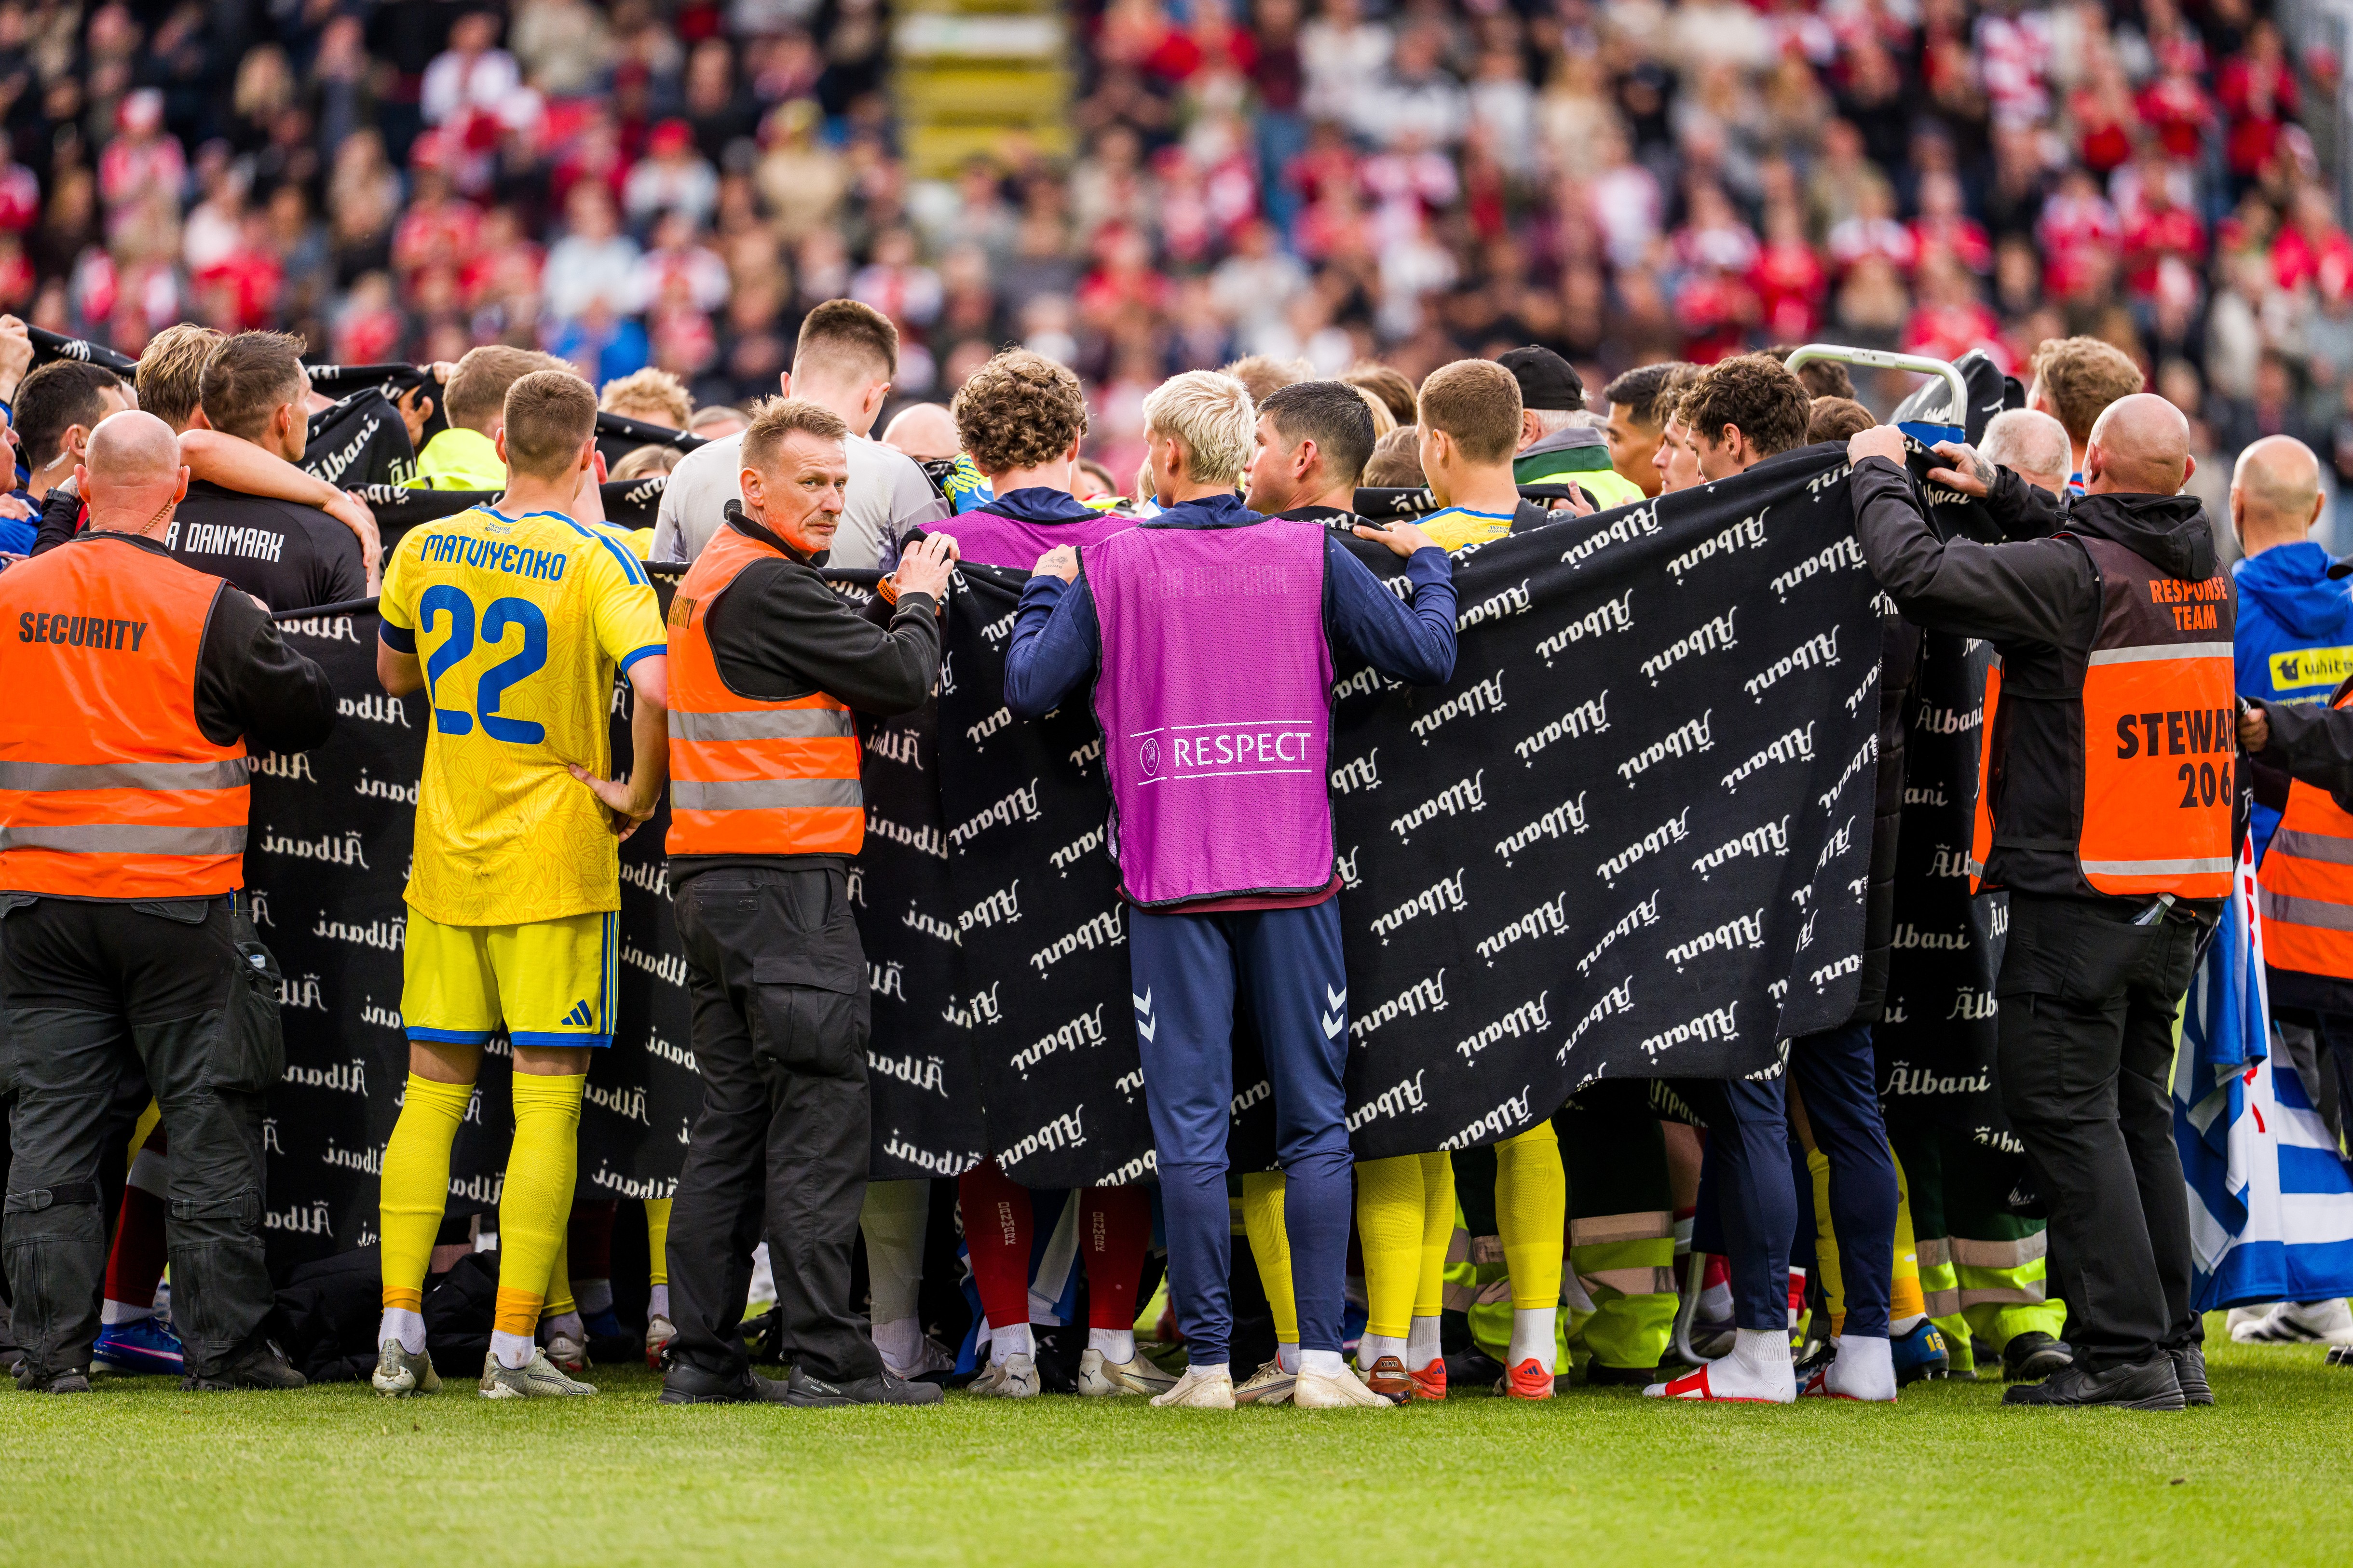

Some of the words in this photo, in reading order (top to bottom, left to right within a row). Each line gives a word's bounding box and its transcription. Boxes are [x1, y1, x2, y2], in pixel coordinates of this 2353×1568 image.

[185, 522, 285, 563] DANMARK
[421, 534, 567, 581] MATVIYENKO
[1561, 507, 1662, 569] Albani
[1666, 507, 1769, 585] Albani
[1770, 536, 1866, 603] Albani
[668, 594, 698, 630] ECURITY
[1455, 579, 1533, 633] Alban
[2149, 576, 2228, 605] RESPONSE
[2172, 604, 2217, 631] TEAM
[19, 611, 148, 652] SECURITY
[1536, 588, 1634, 668] Albani
[1641, 606, 1738, 687] Albani
[419, 584, 548, 745] 22
[1744, 625, 1840, 704] Albani
[1411, 669, 1507, 745] Albani
[1515, 689, 1611, 768] Albani
[1916, 696, 1984, 734] Albani
[2117, 708, 2234, 760] STEWAR
[1144, 741, 1156, 750] UEFA
[1174, 732, 1312, 767] RESPECT
[1332, 747, 1382, 795] Alb
[1618, 708, 1715, 789] Albani
[1721, 720, 1815, 794] Albani
[948, 777, 1042, 855] Albani
[1391, 769, 1486, 845] Albani
[1904, 782, 1949, 807] ani
[2178, 761, 2232, 809] 206
[1495, 791, 1589, 867] Albani
[1597, 806, 1689, 889] Albani
[1692, 814, 1790, 881] Albani
[959, 879, 1023, 935] Alba
[1371, 867, 1468, 946] Albani
[1476, 892, 1569, 968] Albani
[1577, 889, 1660, 977] Albani
[1890, 924, 1971, 950] lbani
[1030, 902, 1126, 979] Albani
[1666, 908, 1765, 973] Albani
[1349, 967, 1449, 1047] Albani
[1456, 990, 1551, 1067] Albani
[1556, 975, 1634, 1066] Albani
[1641, 1000, 1739, 1065] Albani
[1011, 1003, 1106, 1080] Albani
[1346, 1069, 1428, 1132] Alban
[1880, 1060, 1991, 1097] Albani
[997, 1202, 1017, 1246] DANMARK
[1092, 1212, 1106, 1252] DANMARK
[1924, 1332, 1945, 1353] 15
[804, 1374, 821, 1384] HELLY
[820, 1381, 841, 1395] HANSEN
